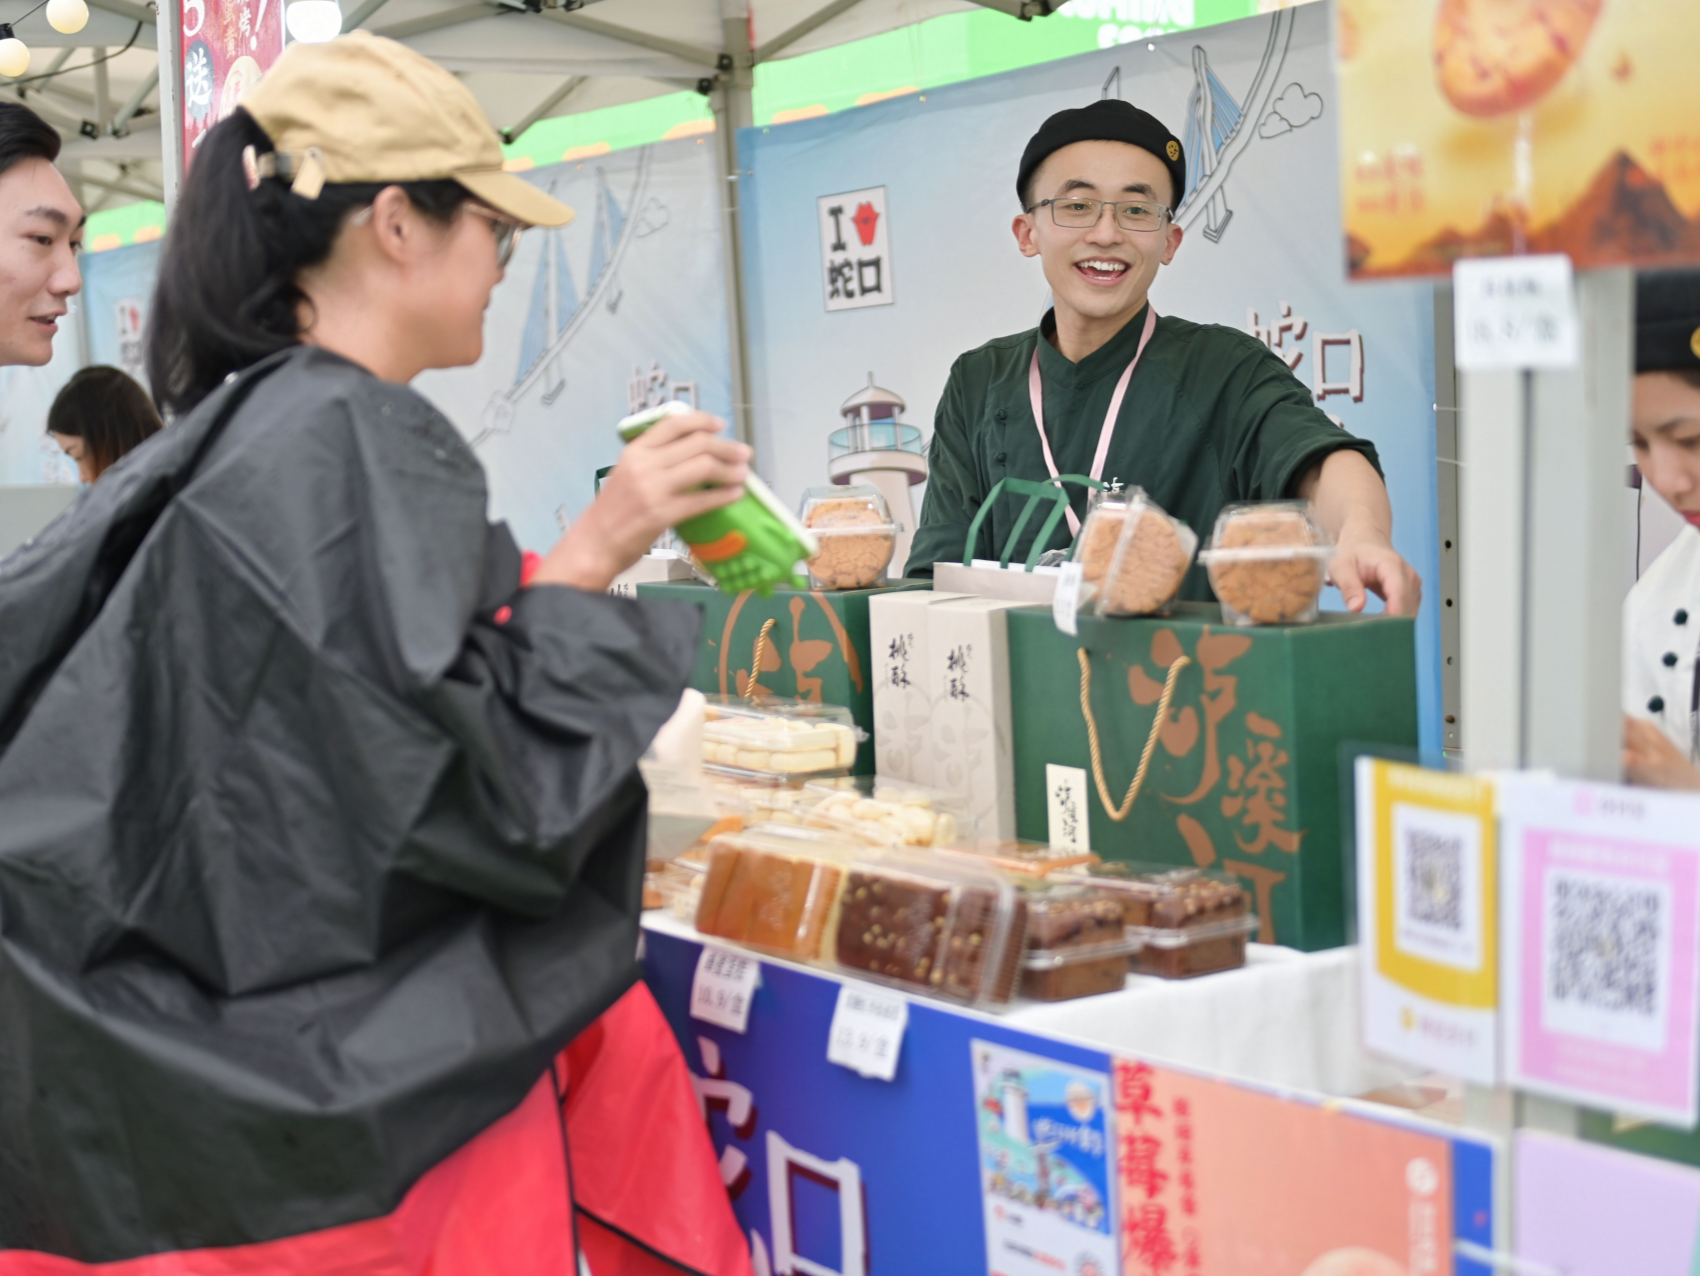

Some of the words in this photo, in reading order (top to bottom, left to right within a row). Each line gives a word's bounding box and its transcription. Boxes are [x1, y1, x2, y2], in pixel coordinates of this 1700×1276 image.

[186, 47, 213, 108] 送
[828, 205, 847, 252] I
[827, 255, 883, 300] 蛇口
